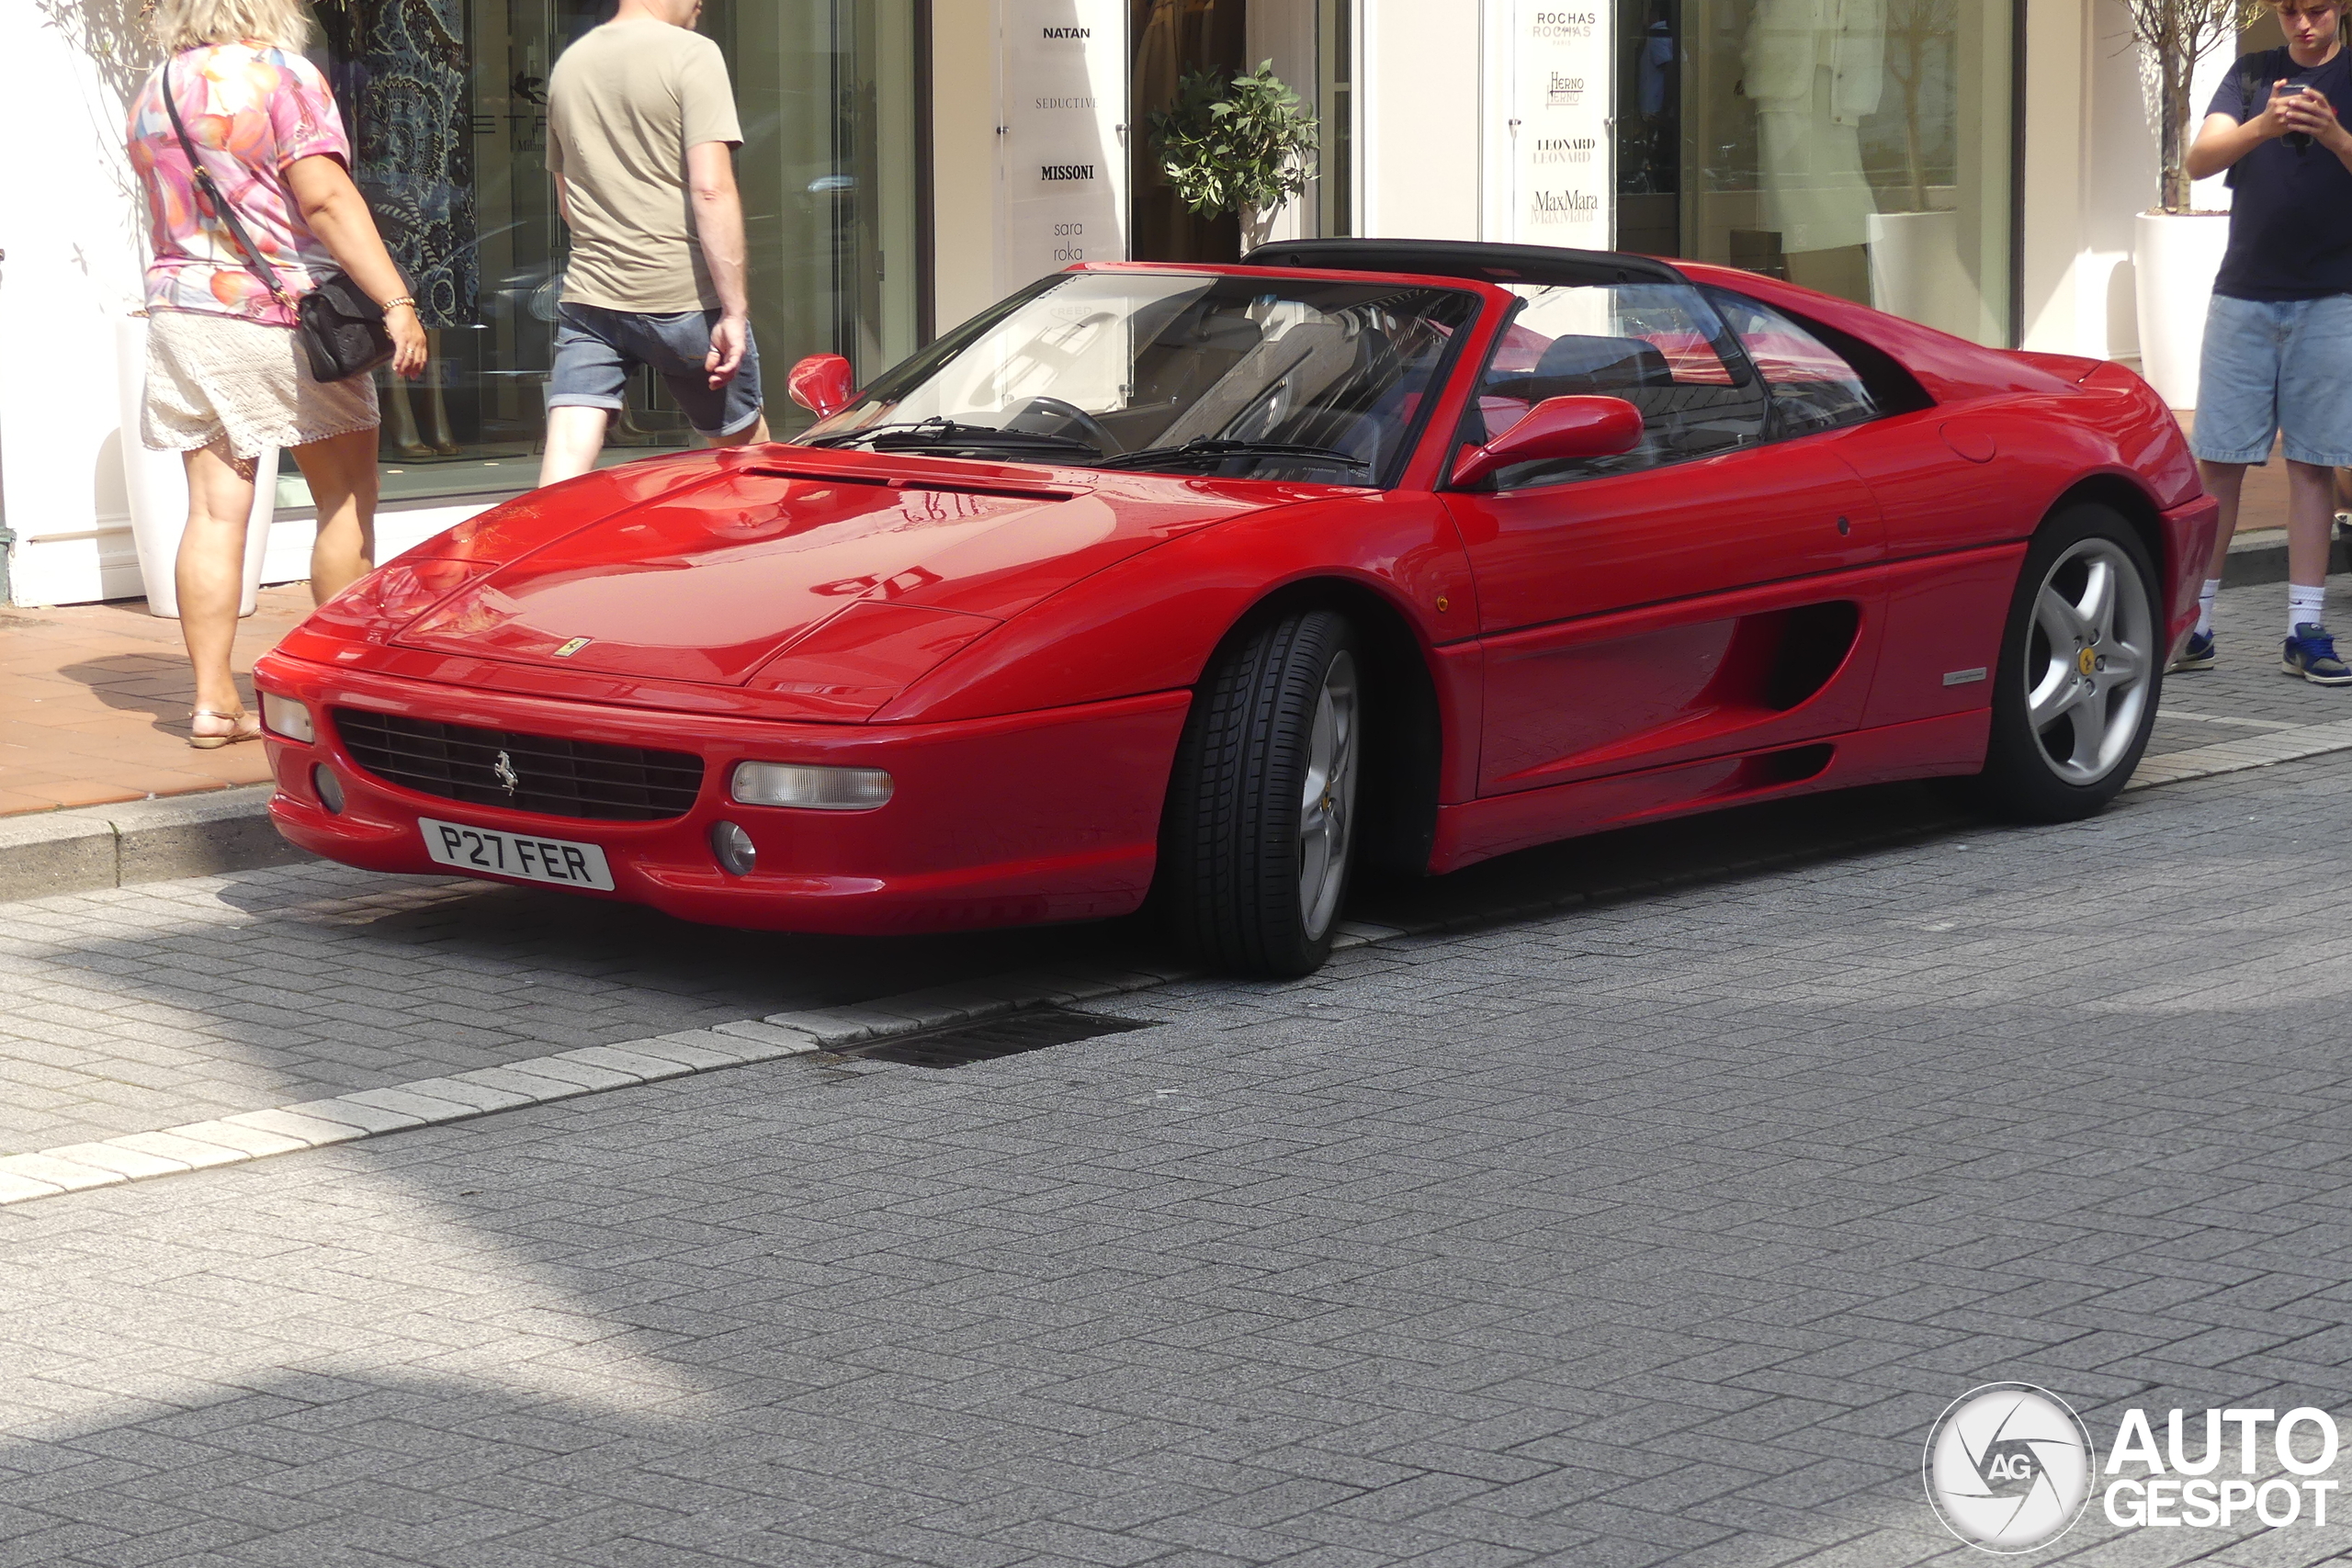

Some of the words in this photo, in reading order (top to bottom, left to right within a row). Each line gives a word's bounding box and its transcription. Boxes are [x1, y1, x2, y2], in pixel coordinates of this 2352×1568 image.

[1537, 12, 1596, 24] ROCHAS
[1043, 28, 1091, 39] NATAN
[1035, 97, 1099, 109] SEDUCTIVE
[1538, 138, 1595, 151] LEONARD
[1041, 164, 1094, 181] MISSONI
[1534, 189, 1599, 211] MaxMara
[1054, 223, 1083, 236] sara
[1054, 241, 1083, 261] roka
[438, 825, 503, 869] P27
[514, 839, 593, 883] FER
